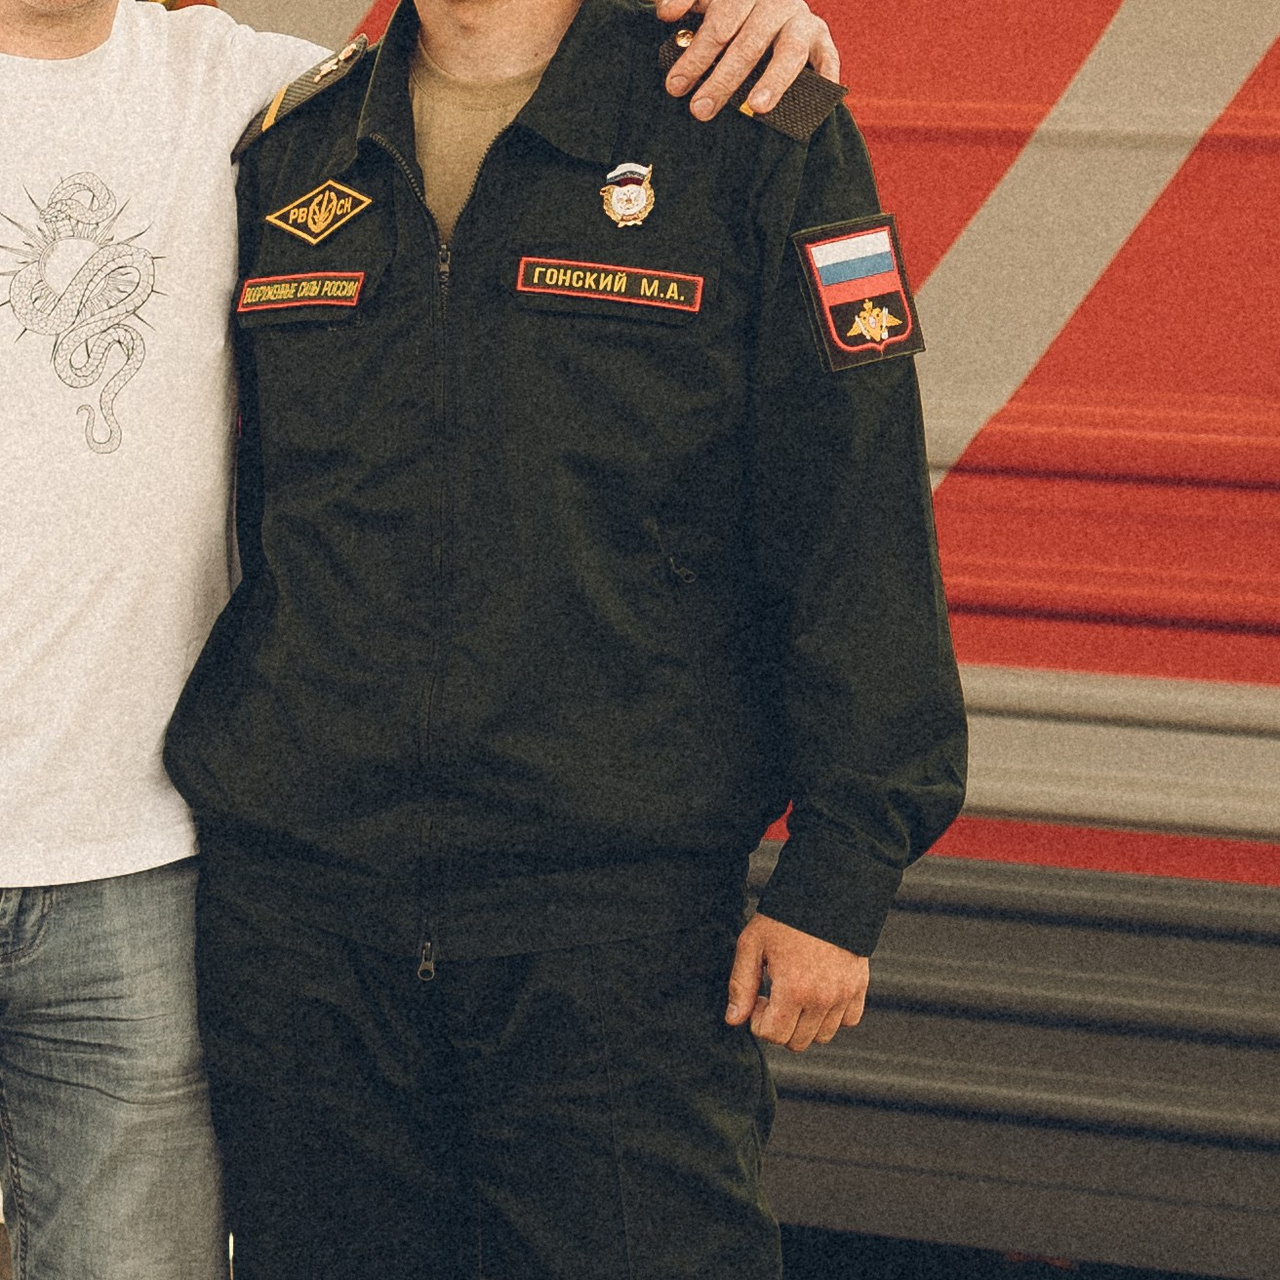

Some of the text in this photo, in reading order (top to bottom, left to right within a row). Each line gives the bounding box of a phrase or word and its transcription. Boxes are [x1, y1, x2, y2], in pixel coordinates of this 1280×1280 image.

[296, 280, 322, 298] СИЛЫ
[320, 280, 359, 297] РОССИИ
[532, 266, 685, 301] ГОНСКИЙ М.А.
